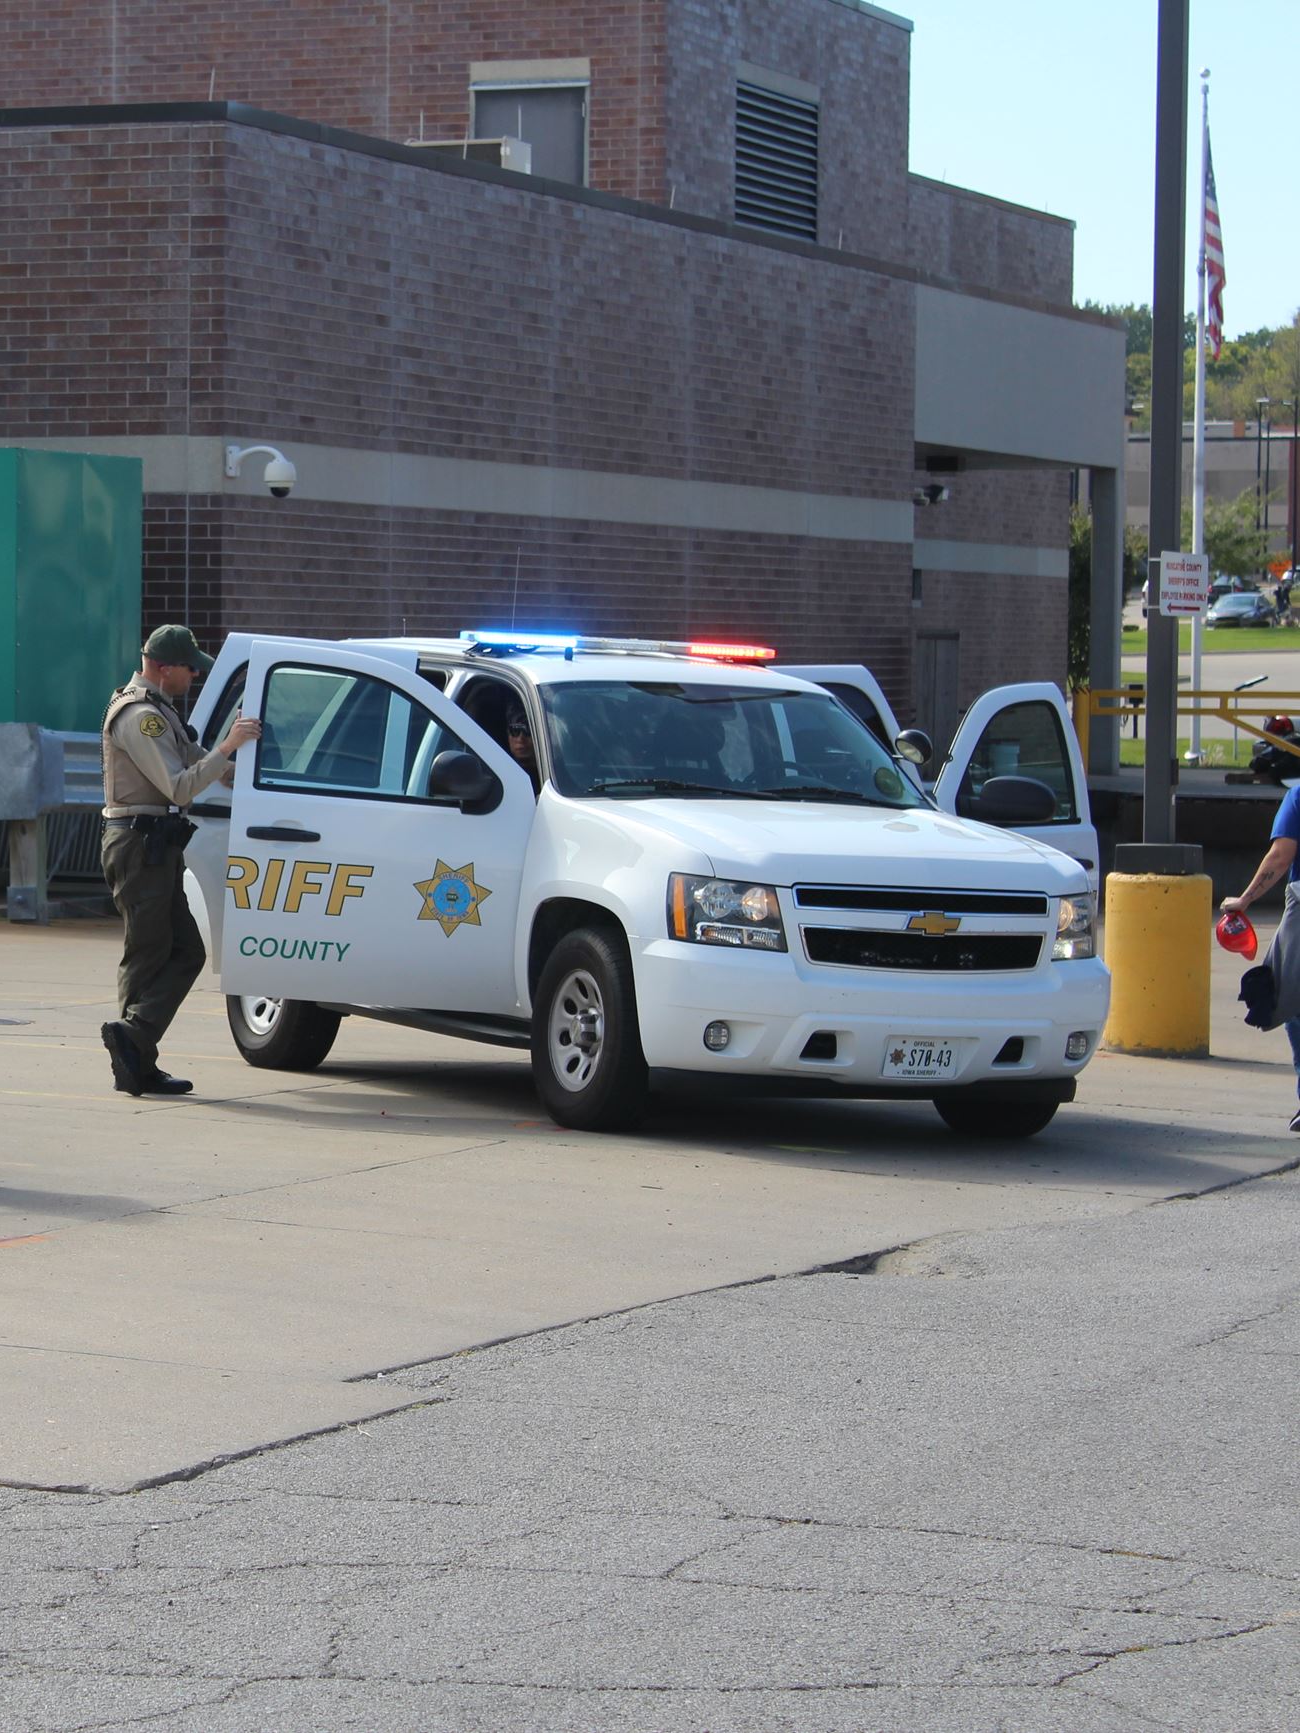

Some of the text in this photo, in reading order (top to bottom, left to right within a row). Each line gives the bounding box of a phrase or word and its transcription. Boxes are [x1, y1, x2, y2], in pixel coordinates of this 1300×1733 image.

[225, 855, 374, 916] RIFF
[240, 936, 351, 962] COUNTY
[908, 1049, 952, 1067] S70-43
